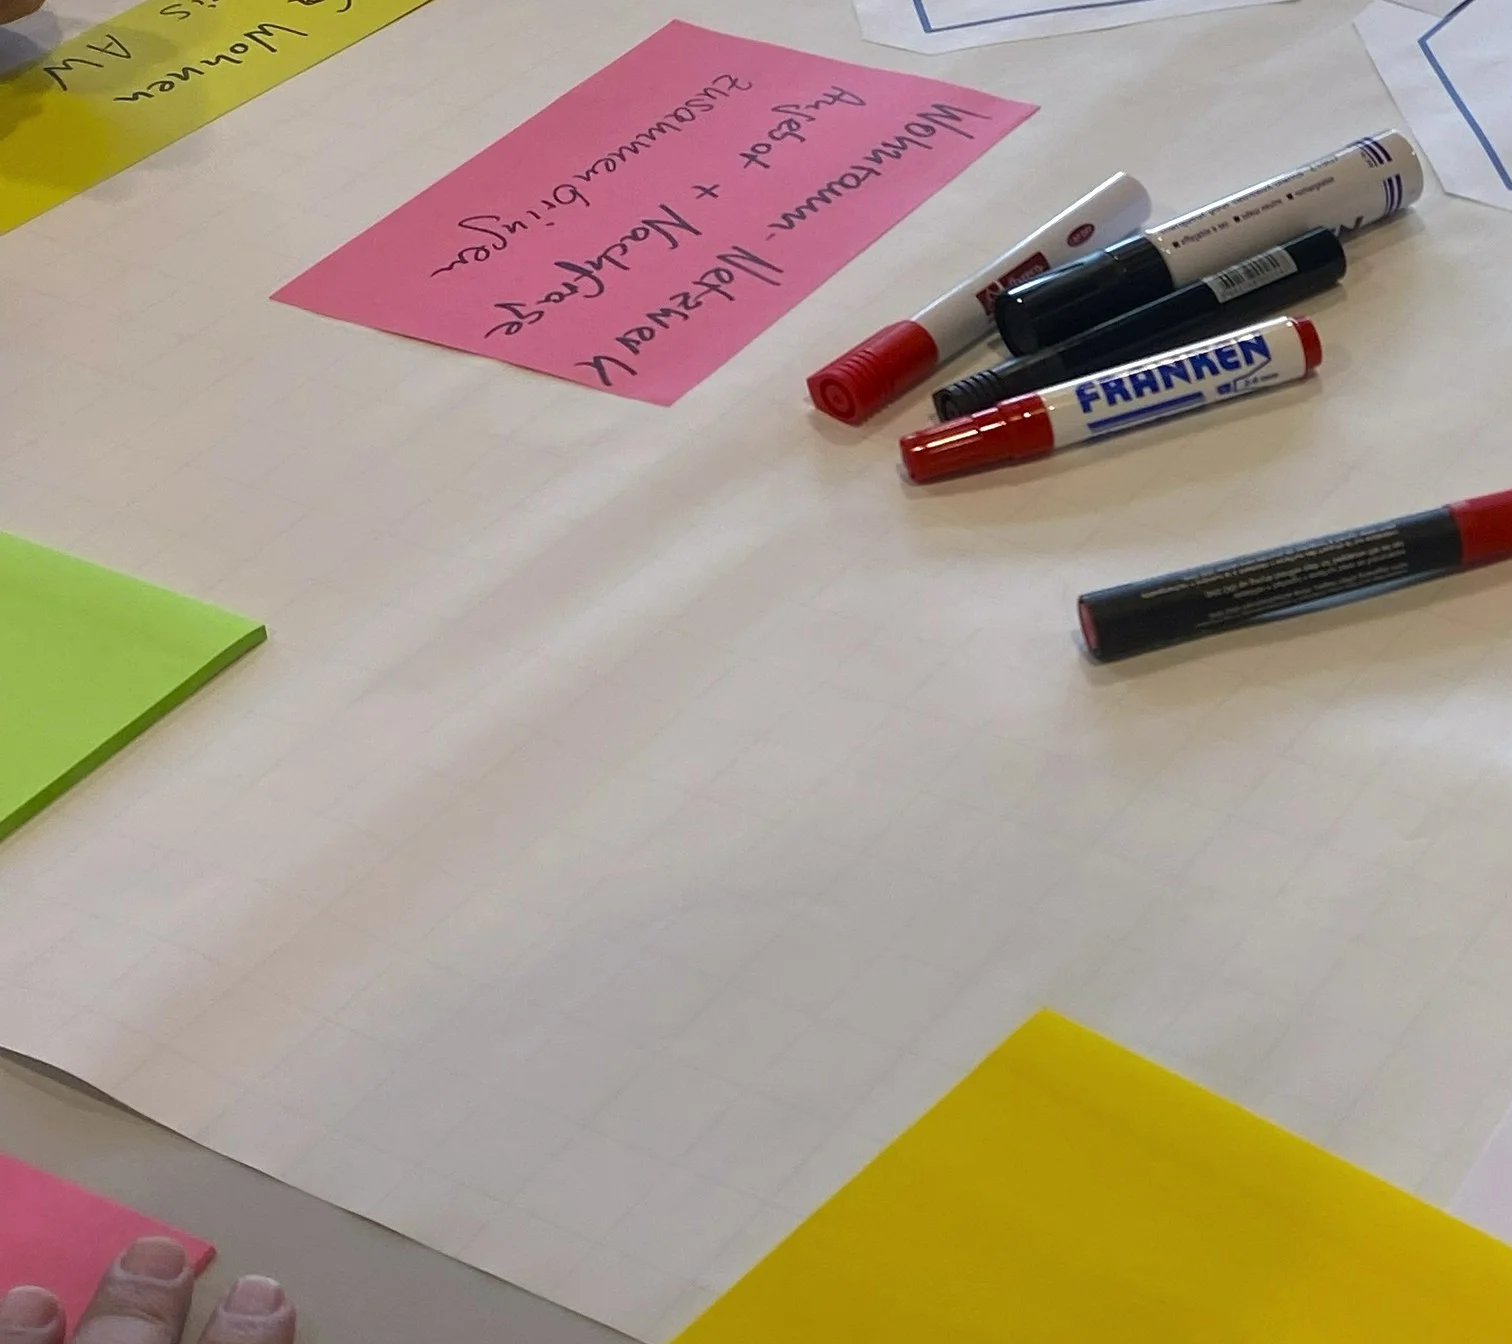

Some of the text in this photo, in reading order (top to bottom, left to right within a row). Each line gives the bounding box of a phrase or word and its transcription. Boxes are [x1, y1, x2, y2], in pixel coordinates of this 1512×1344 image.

[114, 24, 308, 101] Wohnen
[485, 86, 866, 338] Angebot + Nachfrage
[575, 246, 784, 401] Netzwerk
[1076, 334, 1272, 413] FRANKEN
